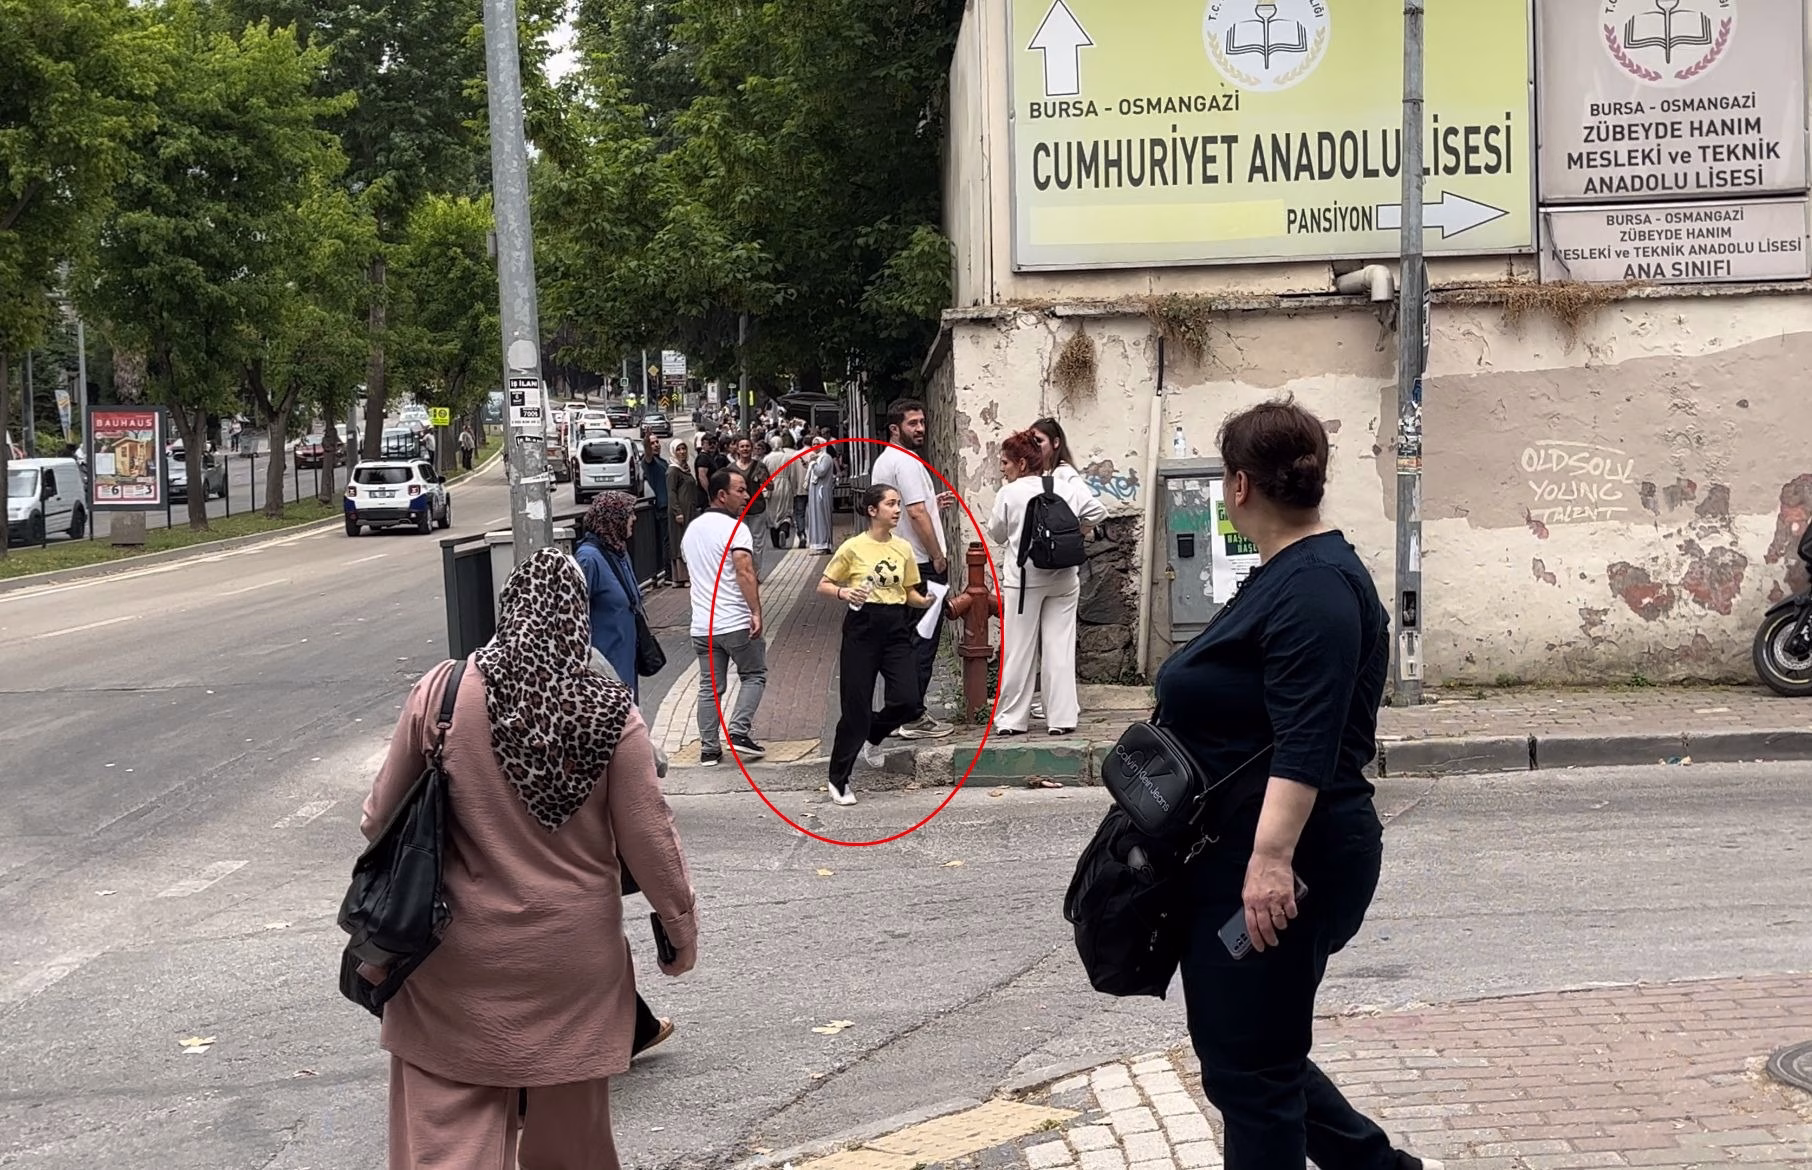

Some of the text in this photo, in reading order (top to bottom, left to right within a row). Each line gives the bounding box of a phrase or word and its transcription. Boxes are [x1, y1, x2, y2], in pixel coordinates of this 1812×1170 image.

[1029, 100, 1099, 119] BURSA
[1118, 89, 1240, 115] OSMANGAZİ
[1590, 101, 1645, 117] BURSA
[1660, 91, 1756, 113] OSMANGAZİ
[1583, 117, 1762, 144] ZÜBEYDE HANIM
[1033, 124, 1239, 191] CUMHURİYET
[1248, 129, 1400, 183] ANADOLU
[1567, 139, 1781, 170] MESLEKİ ve TEKNİK
[1583, 164, 1763, 195] ANADOLU LİSESİ
[1287, 200, 1373, 235] PANSİYON
[1606, 213, 1653, 226] BURSA
[1664, 207, 1744, 224] OSMANGAZİ
[1619, 226, 1732, 242] ZÜBEYDE HANIM
[1614, 249, 1630, 259] ve
[1633, 243, 1685, 258] TEKNİK
[1688, 242, 1755, 256] ANADOLU
[1758, 237, 1802, 253] LİSESİ
[1623, 260, 1731, 280] ANA SINIFI
[96, 418, 153, 427] BAUHAUS
[1528, 479, 1623, 502] YOUNG
[1530, 505, 1628, 521] TALENT
[1115, 744, 1139, 773] Calvin
[1149, 785, 1170, 812] Jeans
